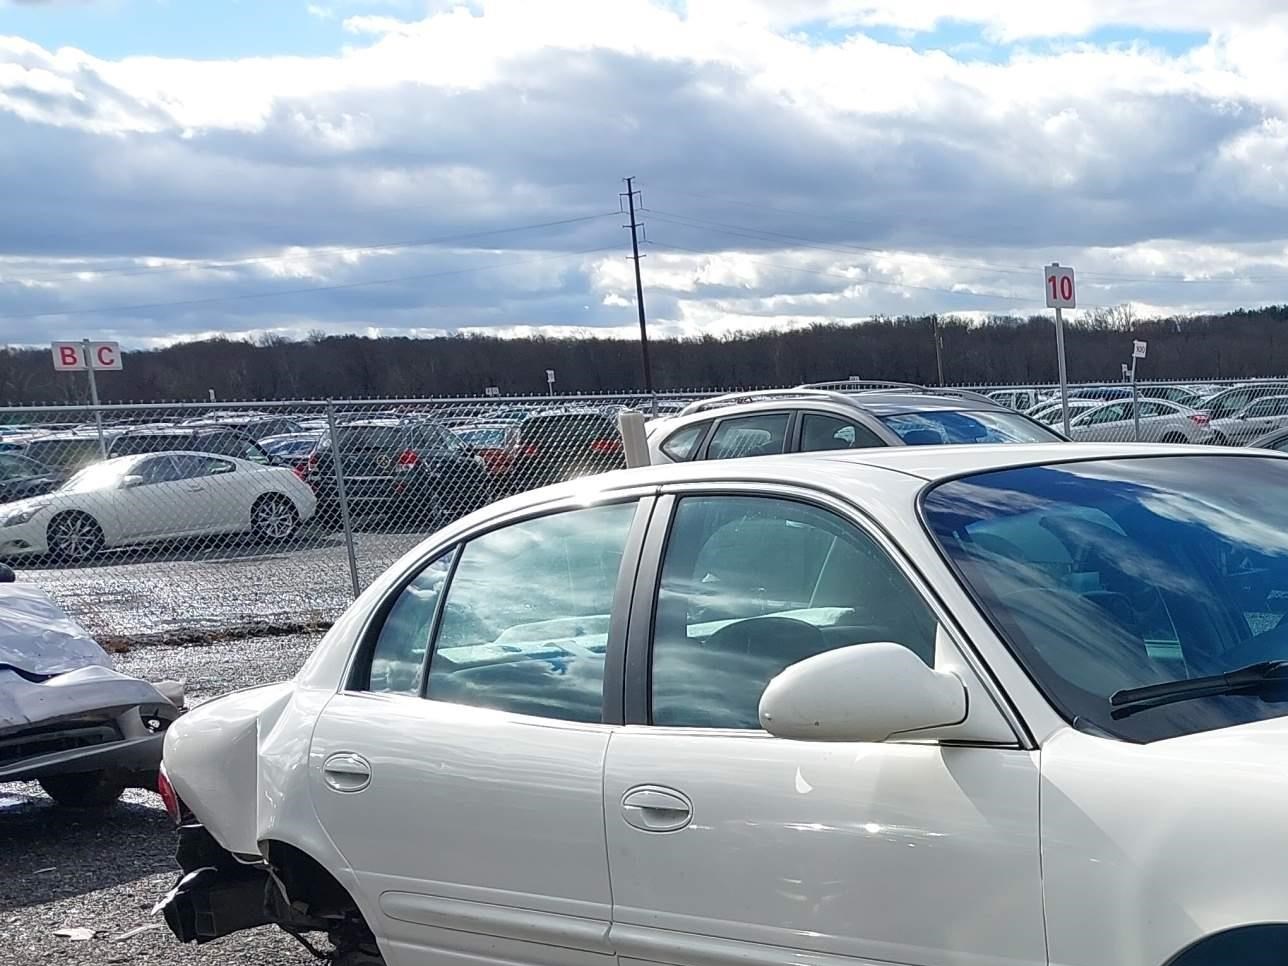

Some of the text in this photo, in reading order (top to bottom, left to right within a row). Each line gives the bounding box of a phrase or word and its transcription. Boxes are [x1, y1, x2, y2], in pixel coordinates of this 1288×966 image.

[1048, 275, 1073, 300] 10
[60, 346, 78, 366] B
[97, 346, 115, 366] C
